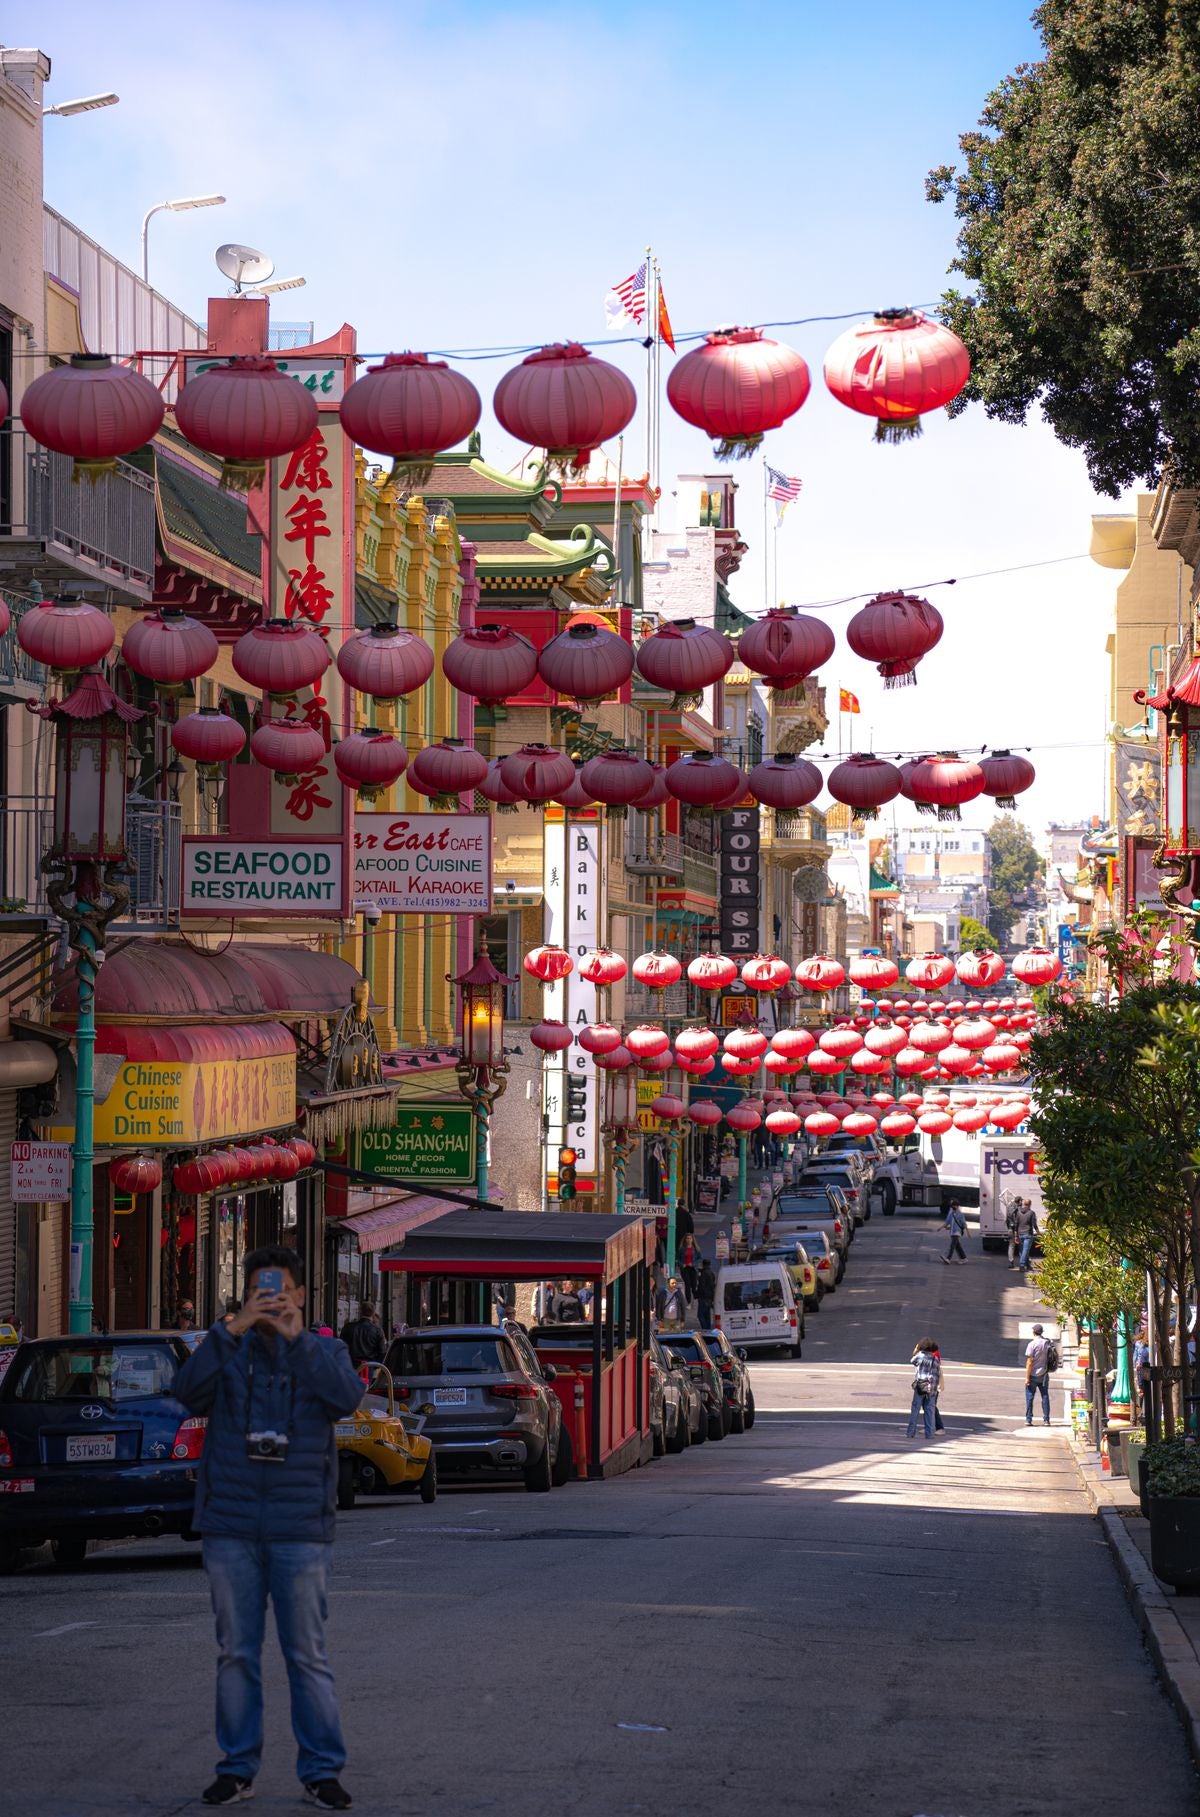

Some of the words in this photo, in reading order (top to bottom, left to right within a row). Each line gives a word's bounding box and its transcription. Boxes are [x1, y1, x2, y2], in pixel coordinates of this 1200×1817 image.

[383, 821, 450, 852] East
[450, 834, 483, 851] CAFÉ
[730, 811, 751, 894] FOUR
[194, 850, 331, 875] SEAFOOD
[416, 854, 482, 873] CUISINE
[408, 876, 484, 895] KARAOKE
[576, 836, 589, 921] Bank
[191, 881, 336, 900] RESTAURANT
[806, 908, 814, 951] GIFTS
[123, 1065, 182, 1086] Chinese
[574, 1009, 588, 1160] Aeca
[124, 1090, 180, 1110] Cuisine
[114, 1116, 151, 1135] Dim
[158, 1116, 184, 1135] Sum
[14, 1144, 29, 1159] NO
[32, 1148, 67, 1159] PARKING
[363, 1132, 391, 1150] OLD
[395, 1133, 468, 1152] SHANGHAI
[385, 1154, 411, 1162] HOME
[17, 1163, 24, 1174] 2
[47, 1163, 53, 1174] 6
[374, 1166, 416, 1174] ORIENTAL
[420, 1167, 457, 1175] FASHION
[17, 1179, 32, 1188] MON
[51, 1179, 62, 1188] FRI
[69, 1443, 112, 1457] 5STW834
